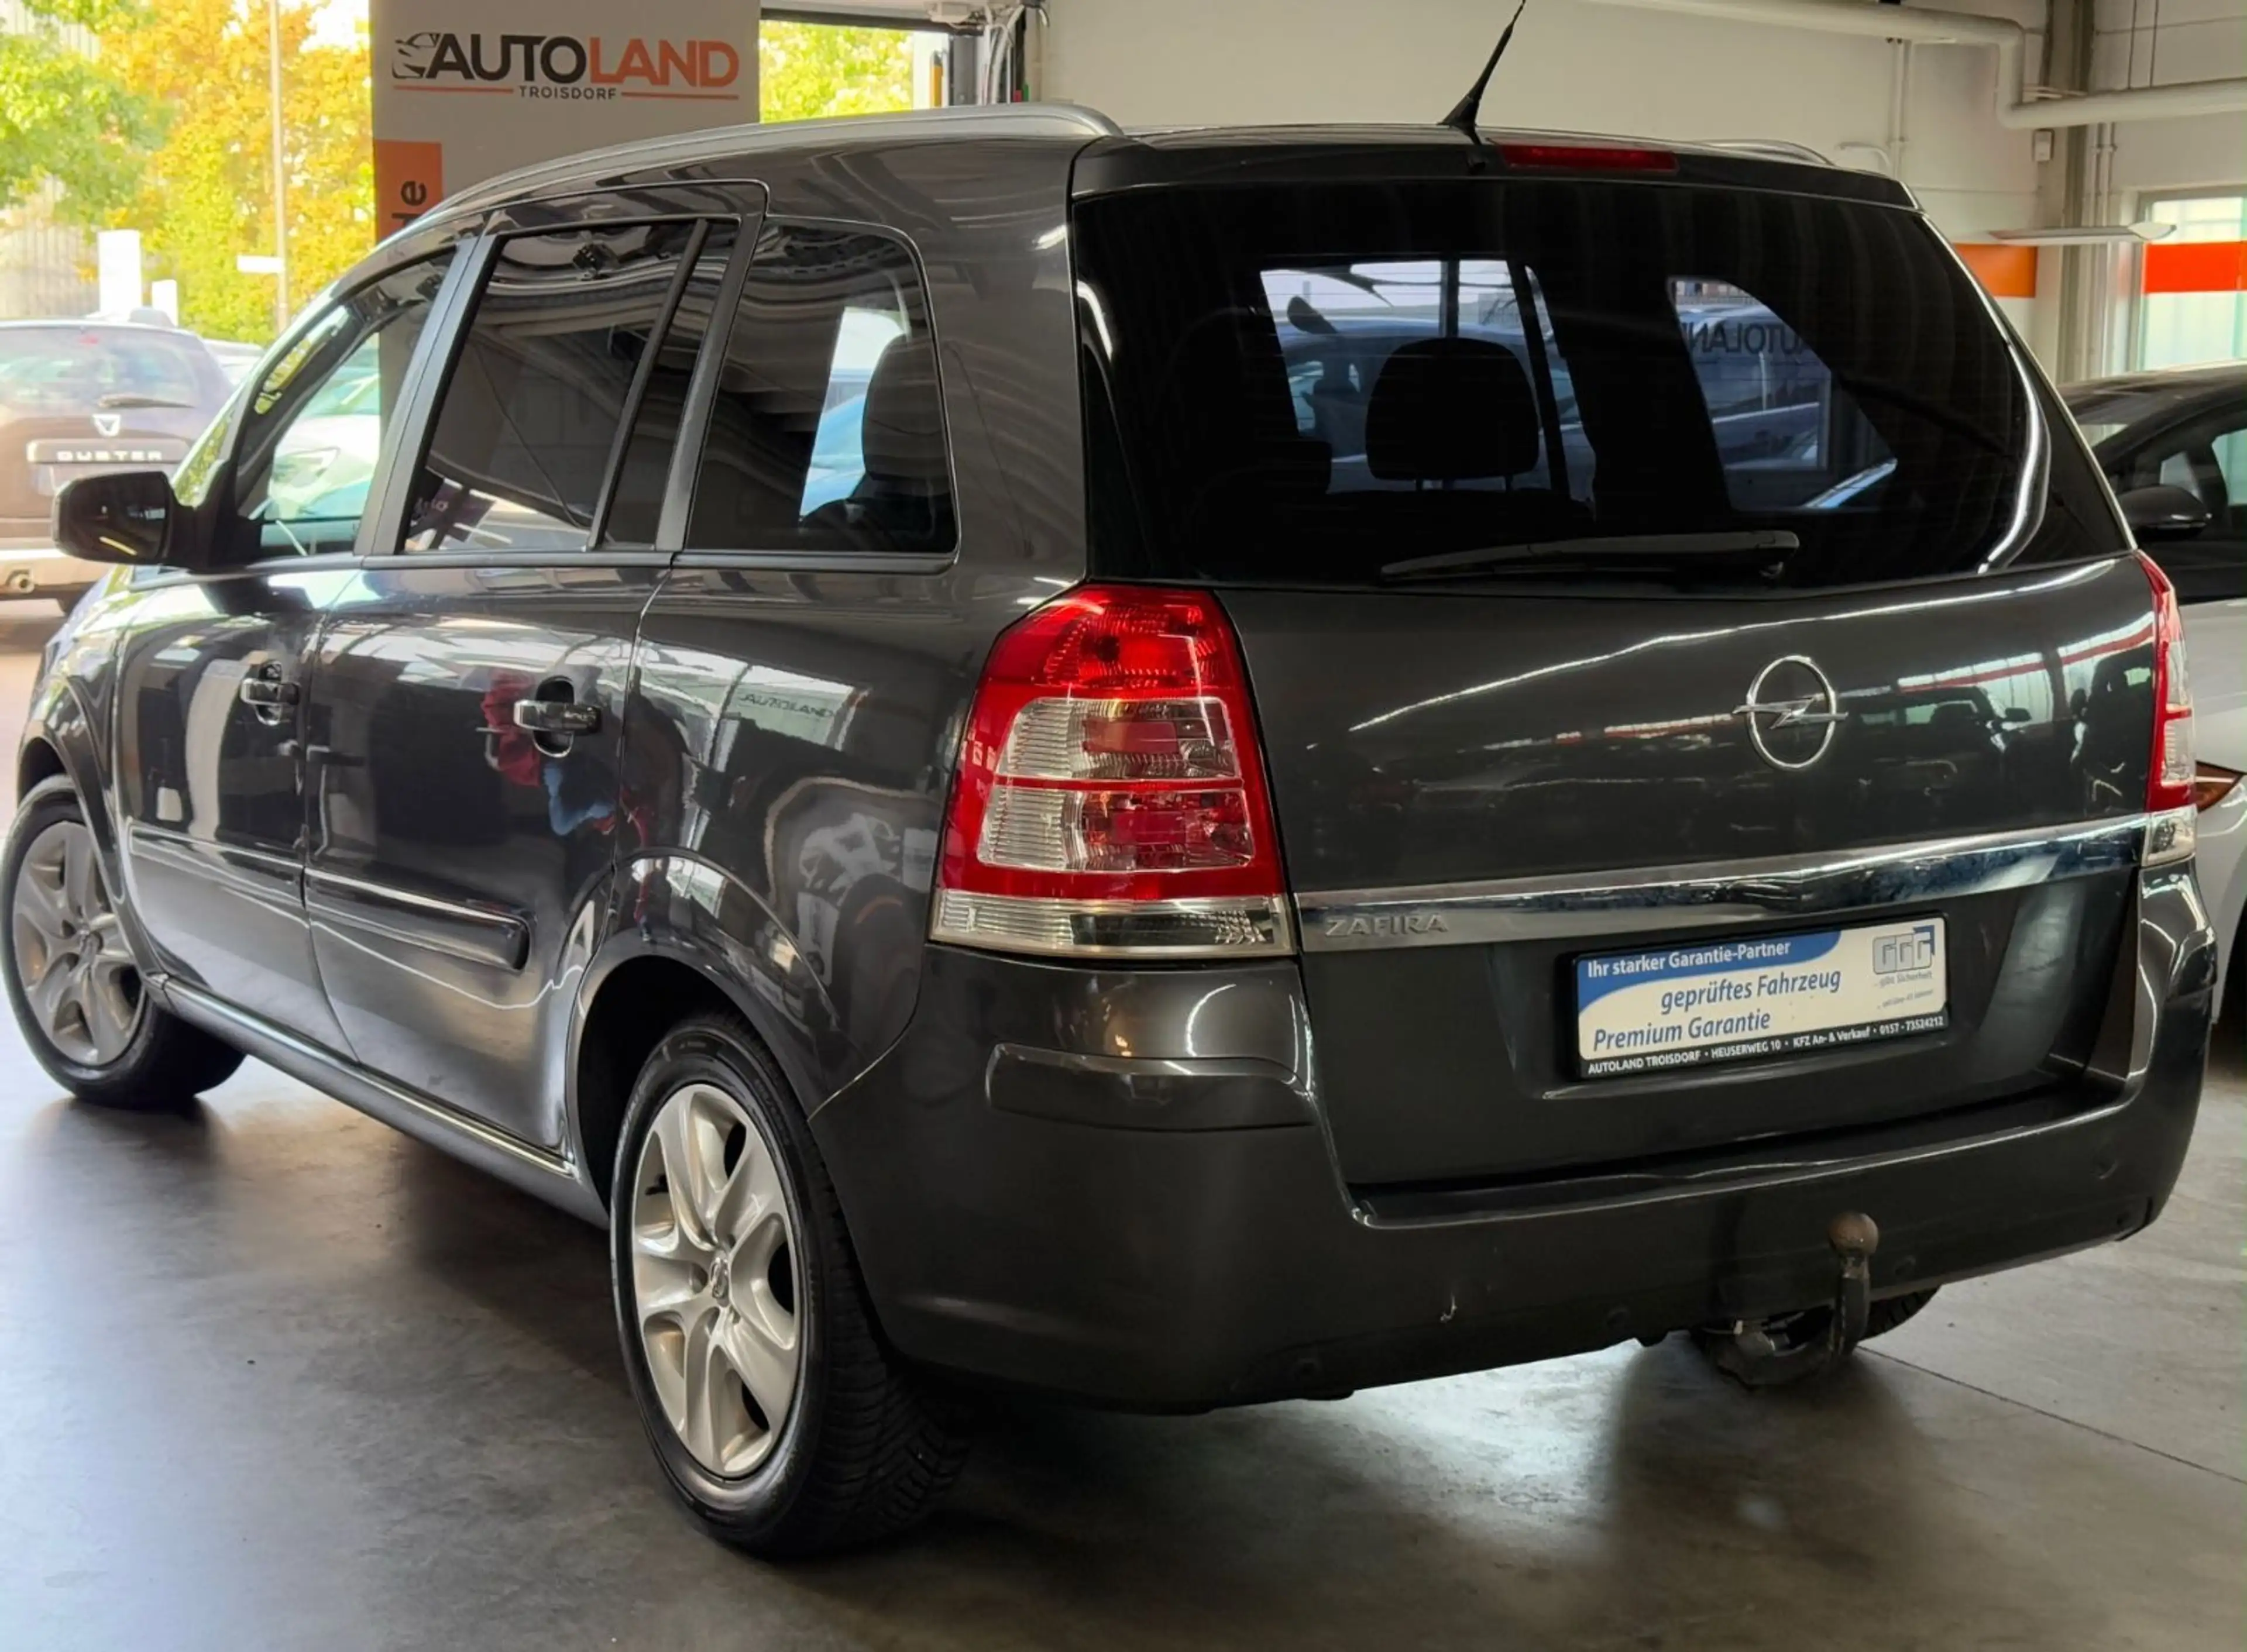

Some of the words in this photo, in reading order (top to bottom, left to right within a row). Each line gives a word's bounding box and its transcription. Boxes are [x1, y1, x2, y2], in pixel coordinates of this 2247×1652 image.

[426, 33, 740, 88] AUTOLAND
[519, 85, 617, 100] TROISDORF
[57, 450, 162, 461] DUSTER
[1325, 913, 1449, 936] ZAFIRA
[1588, 961, 1609, 978] Ihr
[1612, 955, 1666, 975] starker
[1668, 942, 1791, 969] Garantie-Partner
[1661, 978, 1753, 1016] geprüftes
[1757, 970, 1841, 997] Fahrzeug
[1588, 1058, 1644, 1075] AUTOLAND
[1645, 1050, 1700, 1066] TROISDORF
[1710, 1041, 1768, 1059] HEUSERWEG
[1770, 1040, 1781, 1051] 10
[1793, 1036, 1811, 1048] KFZ
[1837, 1026, 1871, 1042] Verkauf
[1880, 1021, 1899, 1035] 0157
[1593, 1022, 1682, 1051] Premium
[1688, 1008, 1771, 1039] Garantie
